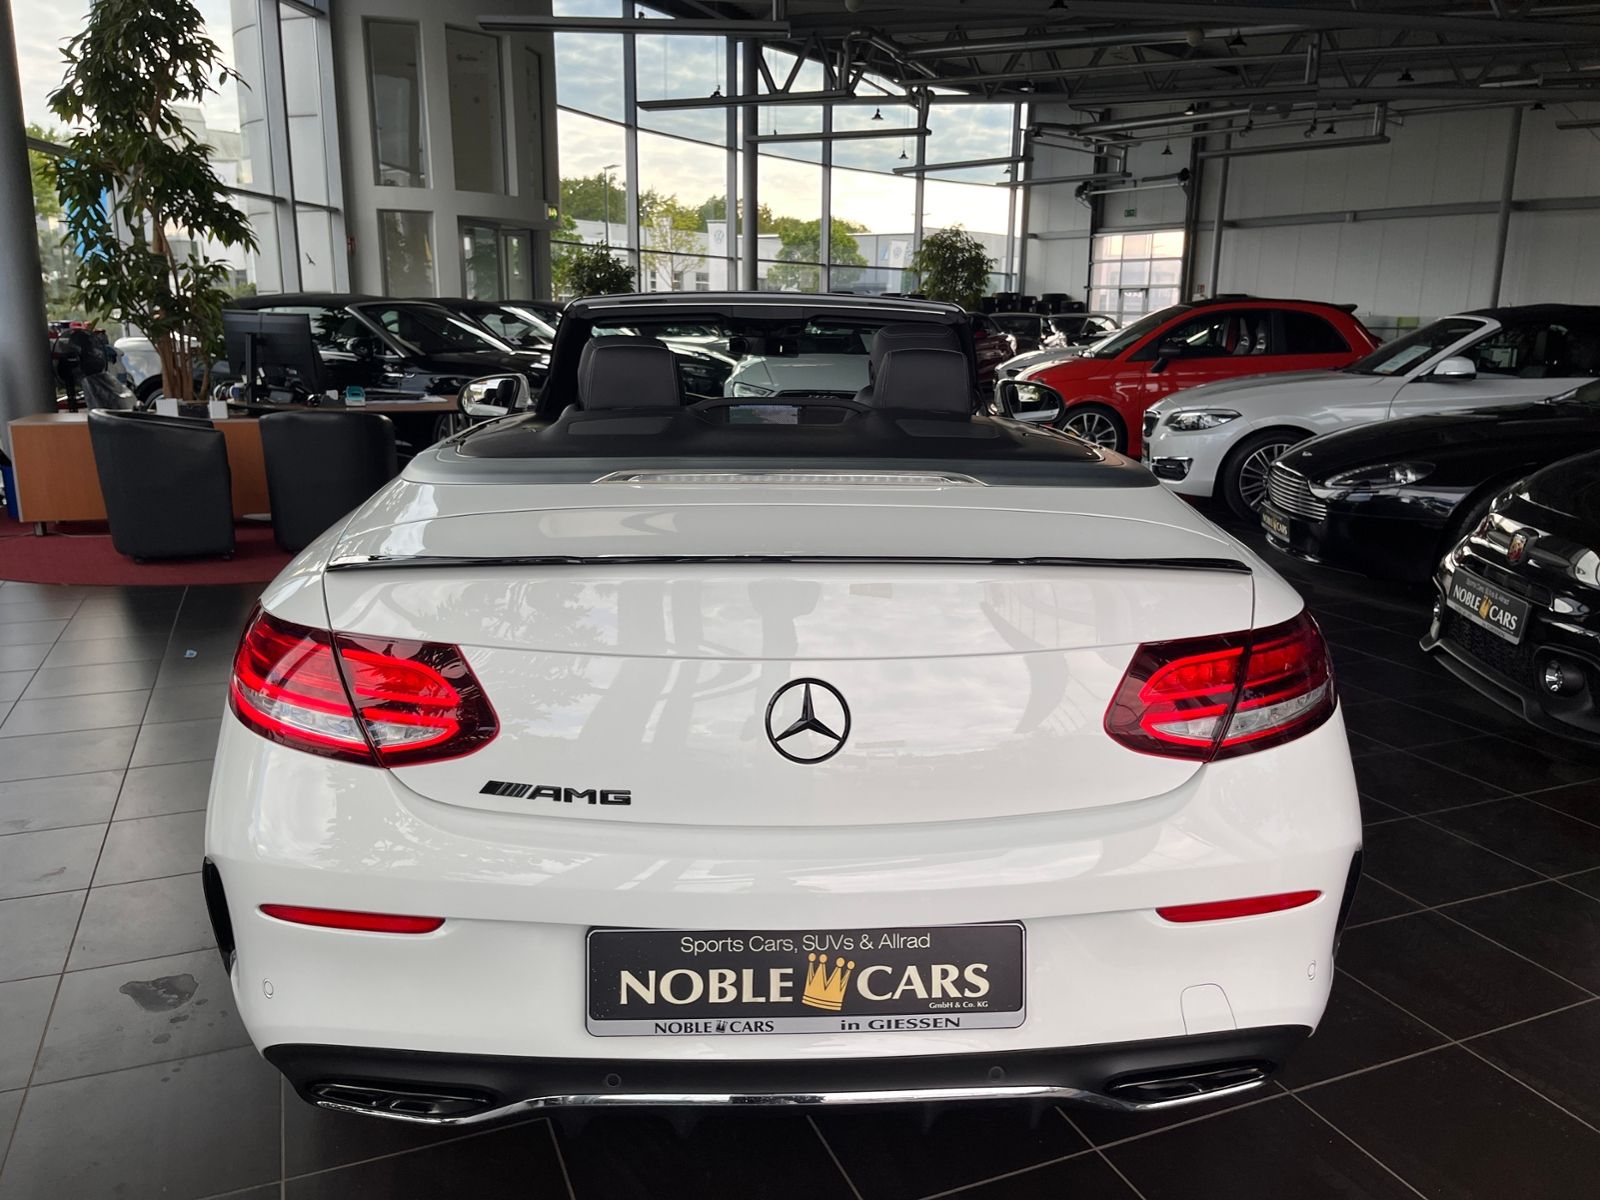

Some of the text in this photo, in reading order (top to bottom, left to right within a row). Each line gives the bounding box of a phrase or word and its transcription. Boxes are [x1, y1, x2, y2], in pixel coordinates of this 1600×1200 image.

[1453, 584, 1482, 611] NOBLE
[1489, 605, 1518, 631] CARS
[526, 784, 632, 806] AMG
[680, 932, 931, 956] Sports Cars, SUVs & Allrad
[619, 962, 991, 1005] NOBLE CARS
[928, 1001, 954, 1009] GmbH
[977, 1000, 989, 1008] KG
[654, 1020, 775, 1034] NOBLE CARS
[840, 1017, 961, 1031] in GIESSEN
